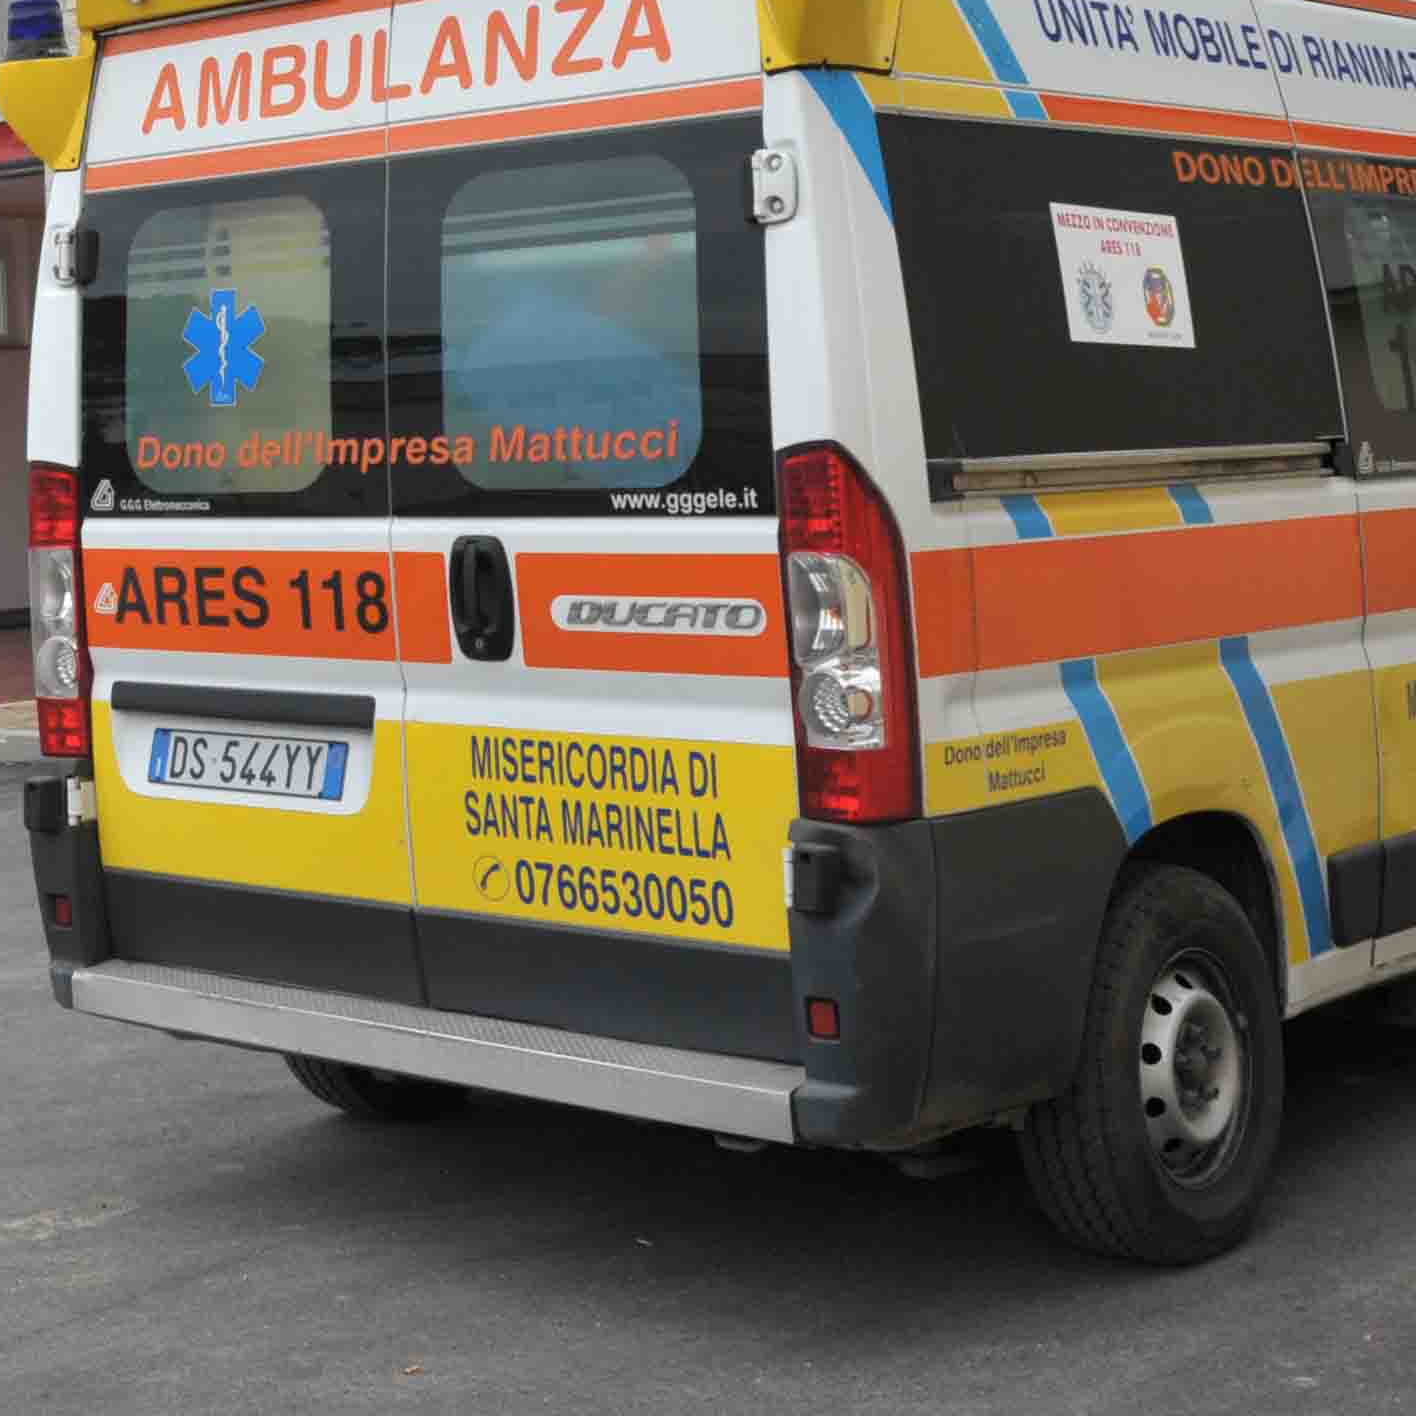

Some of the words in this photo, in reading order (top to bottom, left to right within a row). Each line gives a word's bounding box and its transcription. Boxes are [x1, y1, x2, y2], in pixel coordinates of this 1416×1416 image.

[1144, 8, 1267, 70] MOBILE
[1268, 29, 1303, 75] DI
[1172, 151, 1266, 185] DONO
[137, 434, 227, 470] Dono
[236, 430, 473, 473] dell'Impresa
[488, 419, 679, 462] Mattucci
[610, 487, 758, 514] www.gggele.it
[115, 565, 270, 629] ARES
[289, 568, 390, 634] 118
[566, 600, 764, 630] DUCATO
[170, 735, 208, 780] DS
[471, 734, 680, 797] MISERICORDIA
[689, 750, 718, 799] DI
[944, 744, 981, 765] Dono
[988, 761, 1046, 792] Mattucci
[464, 790, 554, 843] SANTA
[561, 798, 732, 861] MARINELLA
[515, 859, 734, 929] 0766530050
